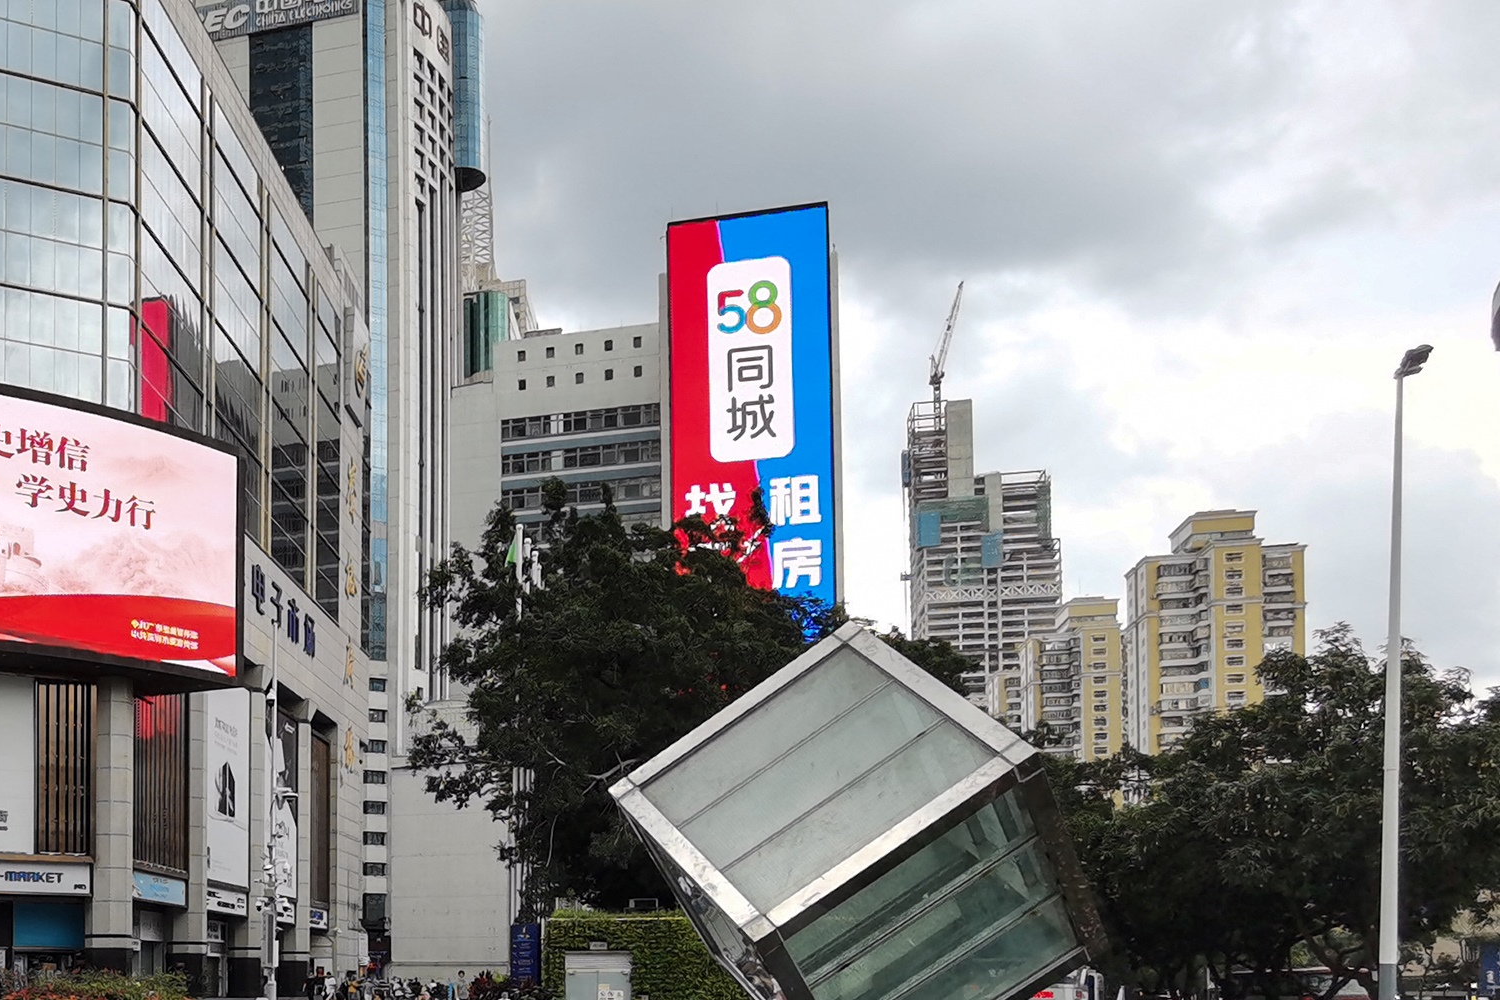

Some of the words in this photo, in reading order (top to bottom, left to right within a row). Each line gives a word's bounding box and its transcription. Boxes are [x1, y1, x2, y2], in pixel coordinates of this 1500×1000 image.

[199, 4, 250, 32] EC
[256, 11, 286, 26] CHINA
[717, 280, 782, 334] 58
[726, 345, 777, 441] 同城
[15, 473, 156, 530] 学史力行
[769, 475, 822, 589] 租房
